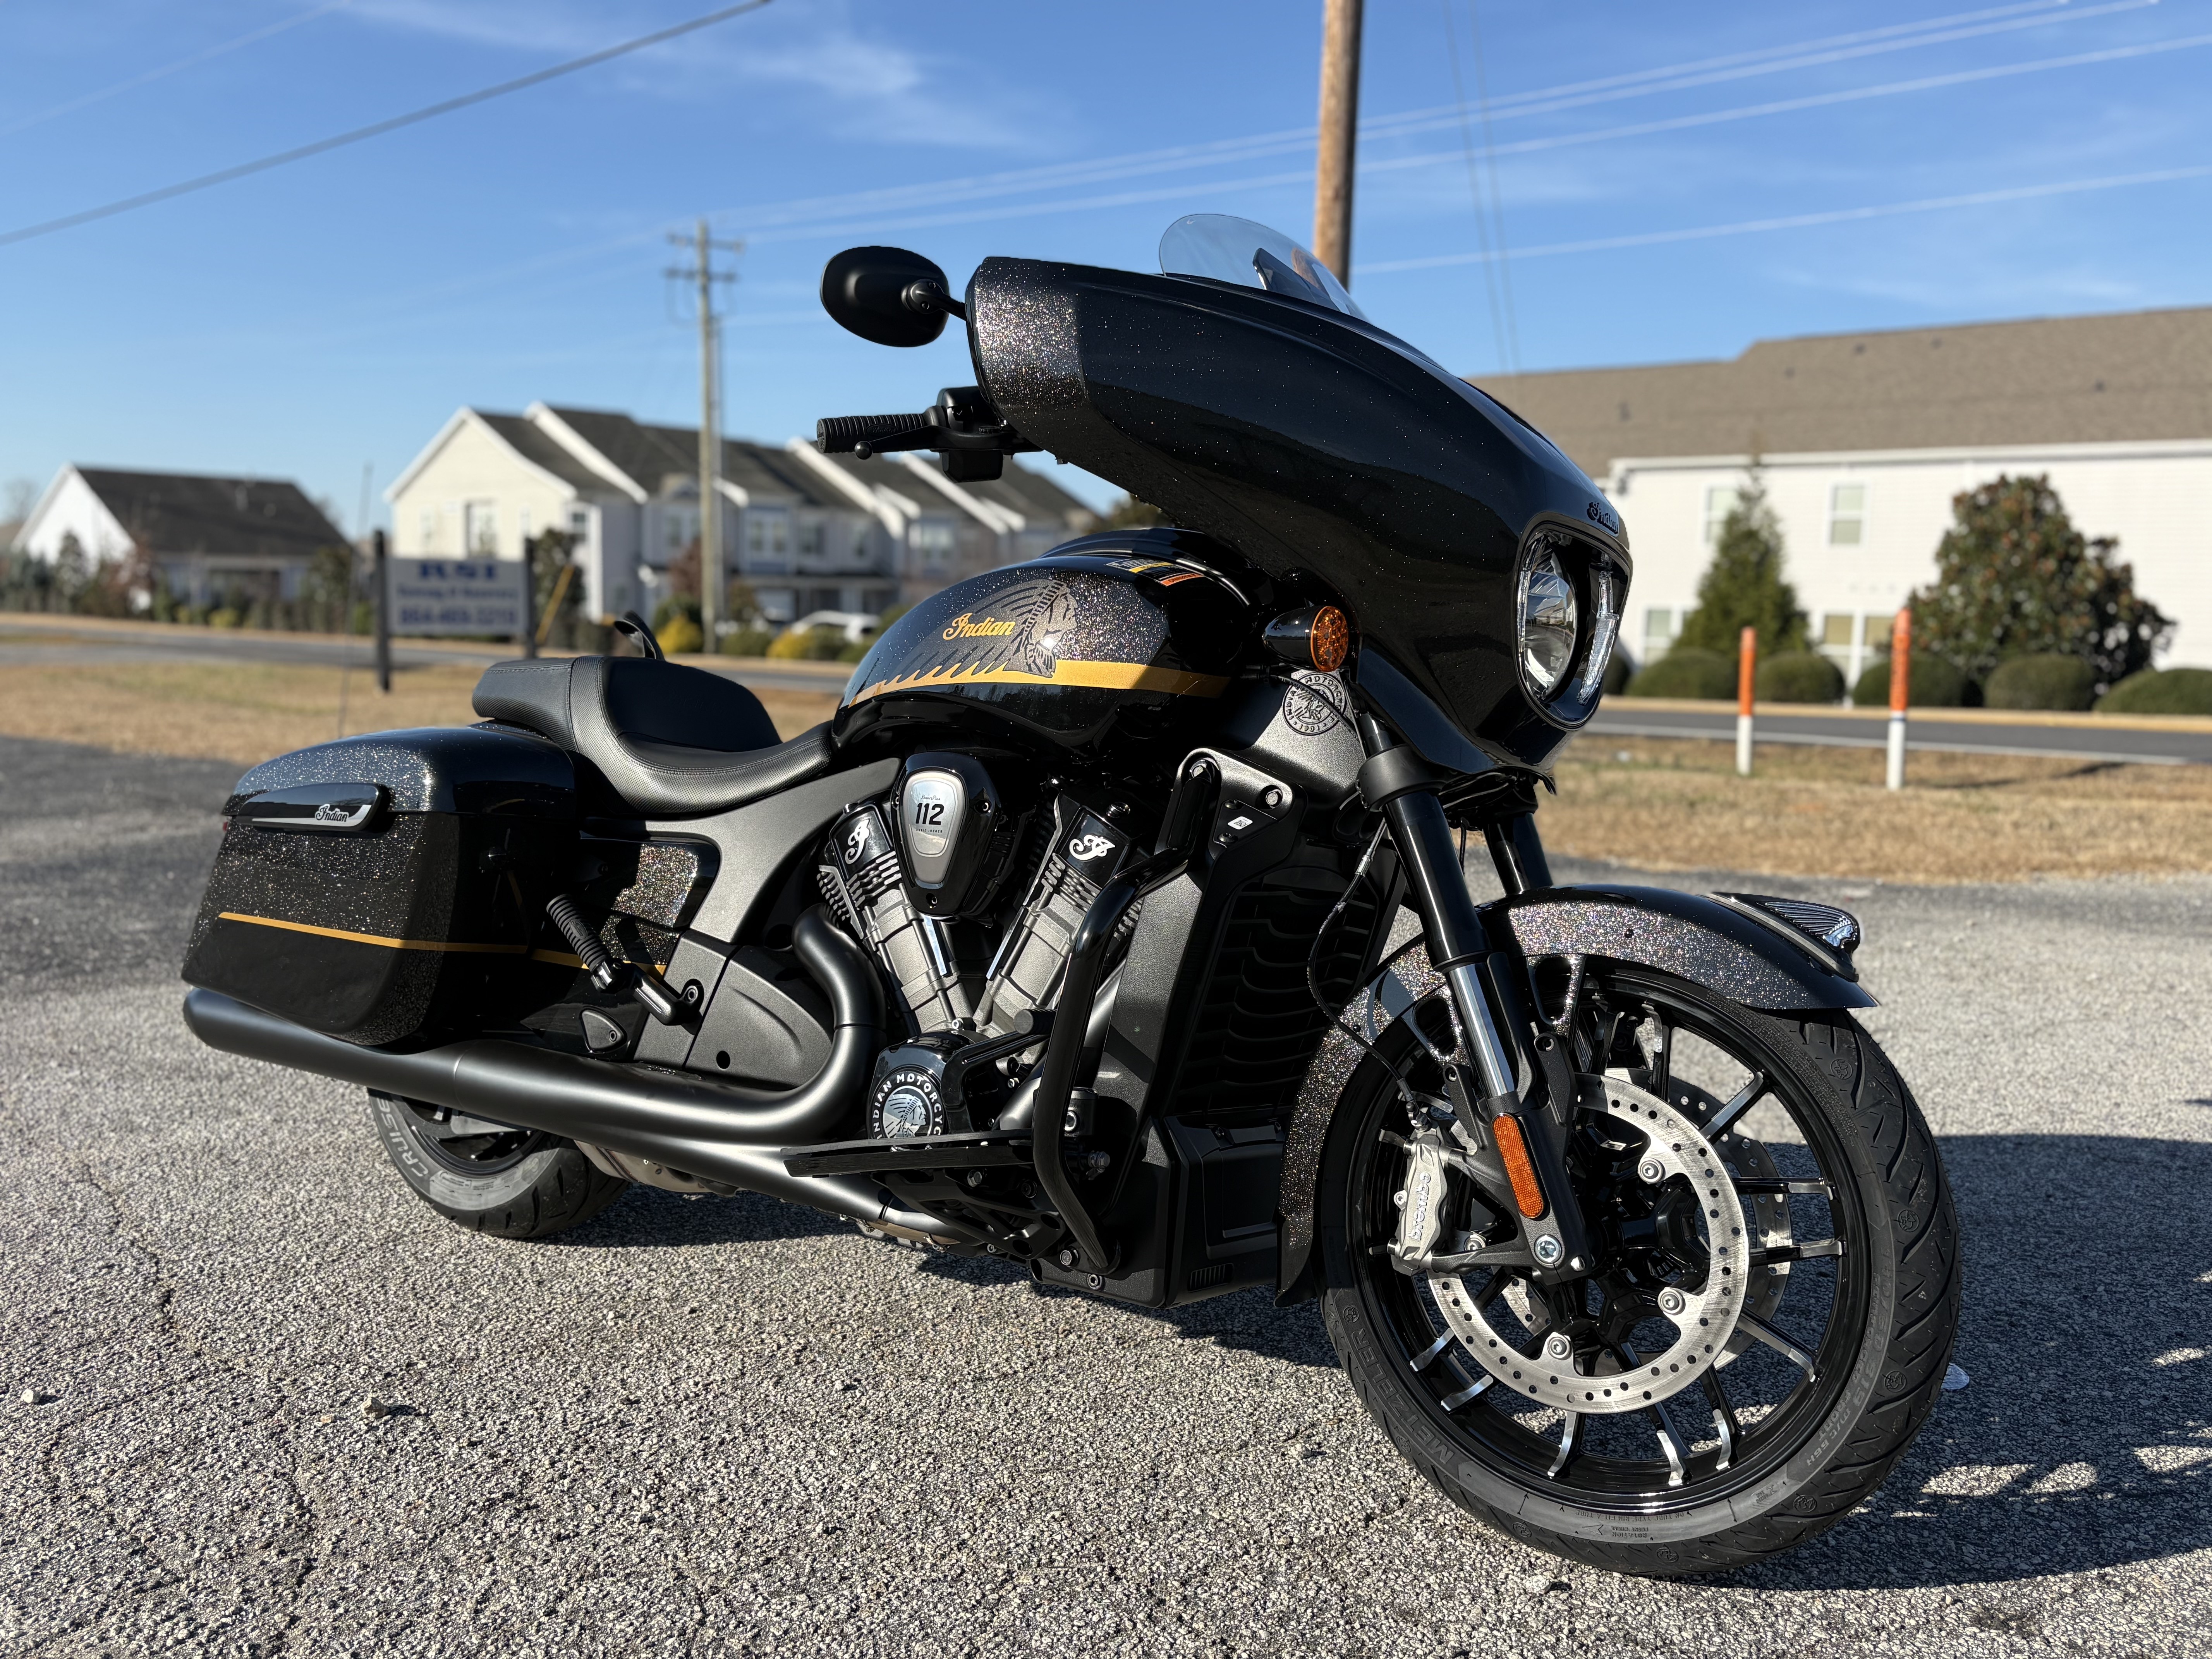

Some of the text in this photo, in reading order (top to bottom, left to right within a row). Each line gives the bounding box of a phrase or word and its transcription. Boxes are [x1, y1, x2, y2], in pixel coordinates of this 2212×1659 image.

[1587, 502, 1619, 534] Indian
[943, 613, 1016, 640] Indian
[316, 805, 348, 822] Indian
[915, 803, 945, 825] 112
[897, 1073, 943, 1135] MOTORCYC
[1408, 1171, 1431, 1240] brembo
[1351, 1328, 1455, 1465] METZELER
[1817, 1389, 1851, 1440] FRONT
[1575, 1510, 1593, 1518] TUBE
